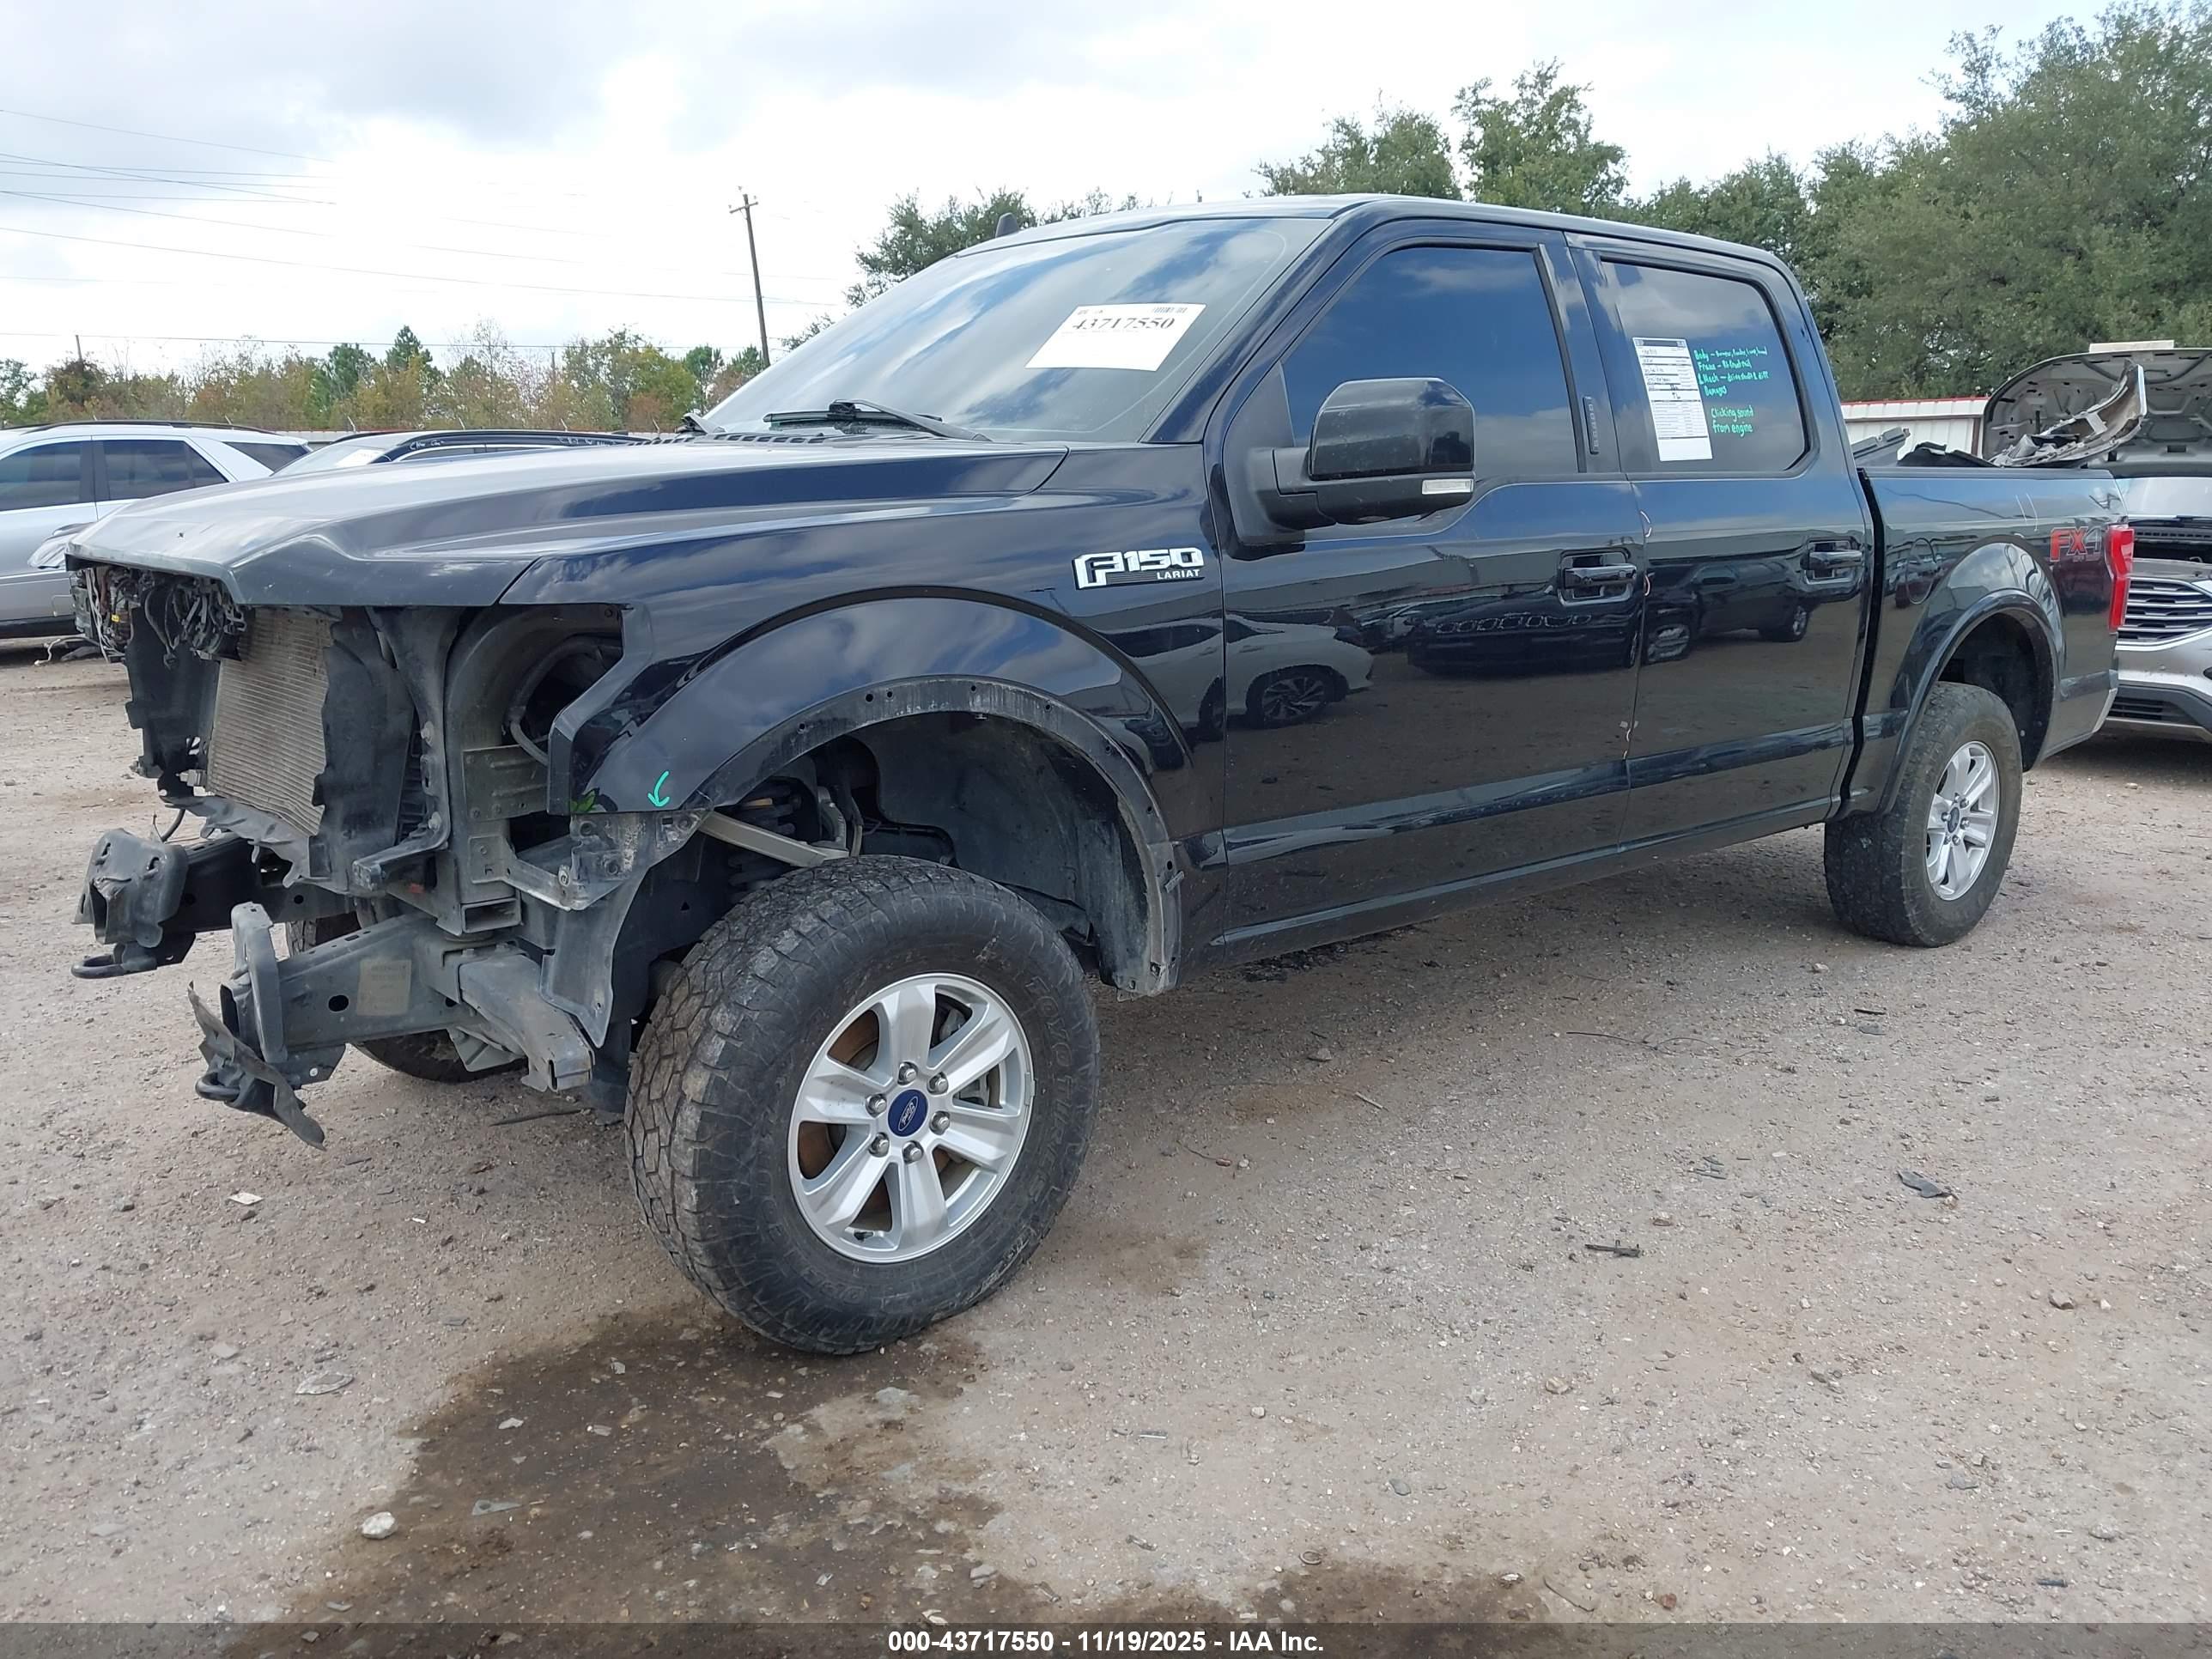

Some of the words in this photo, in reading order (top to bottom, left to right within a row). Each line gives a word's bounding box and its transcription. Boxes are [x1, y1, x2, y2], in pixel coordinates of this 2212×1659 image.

[1073, 317, 1176, 330] 43717550
[1711, 407, 1737, 422] Clicking
[1737, 404, 1753, 418] sound
[1731, 422, 1753, 437] engine
[2050, 526, 2102, 562] FX4
[1156, 568, 1200, 580] LARIAT
